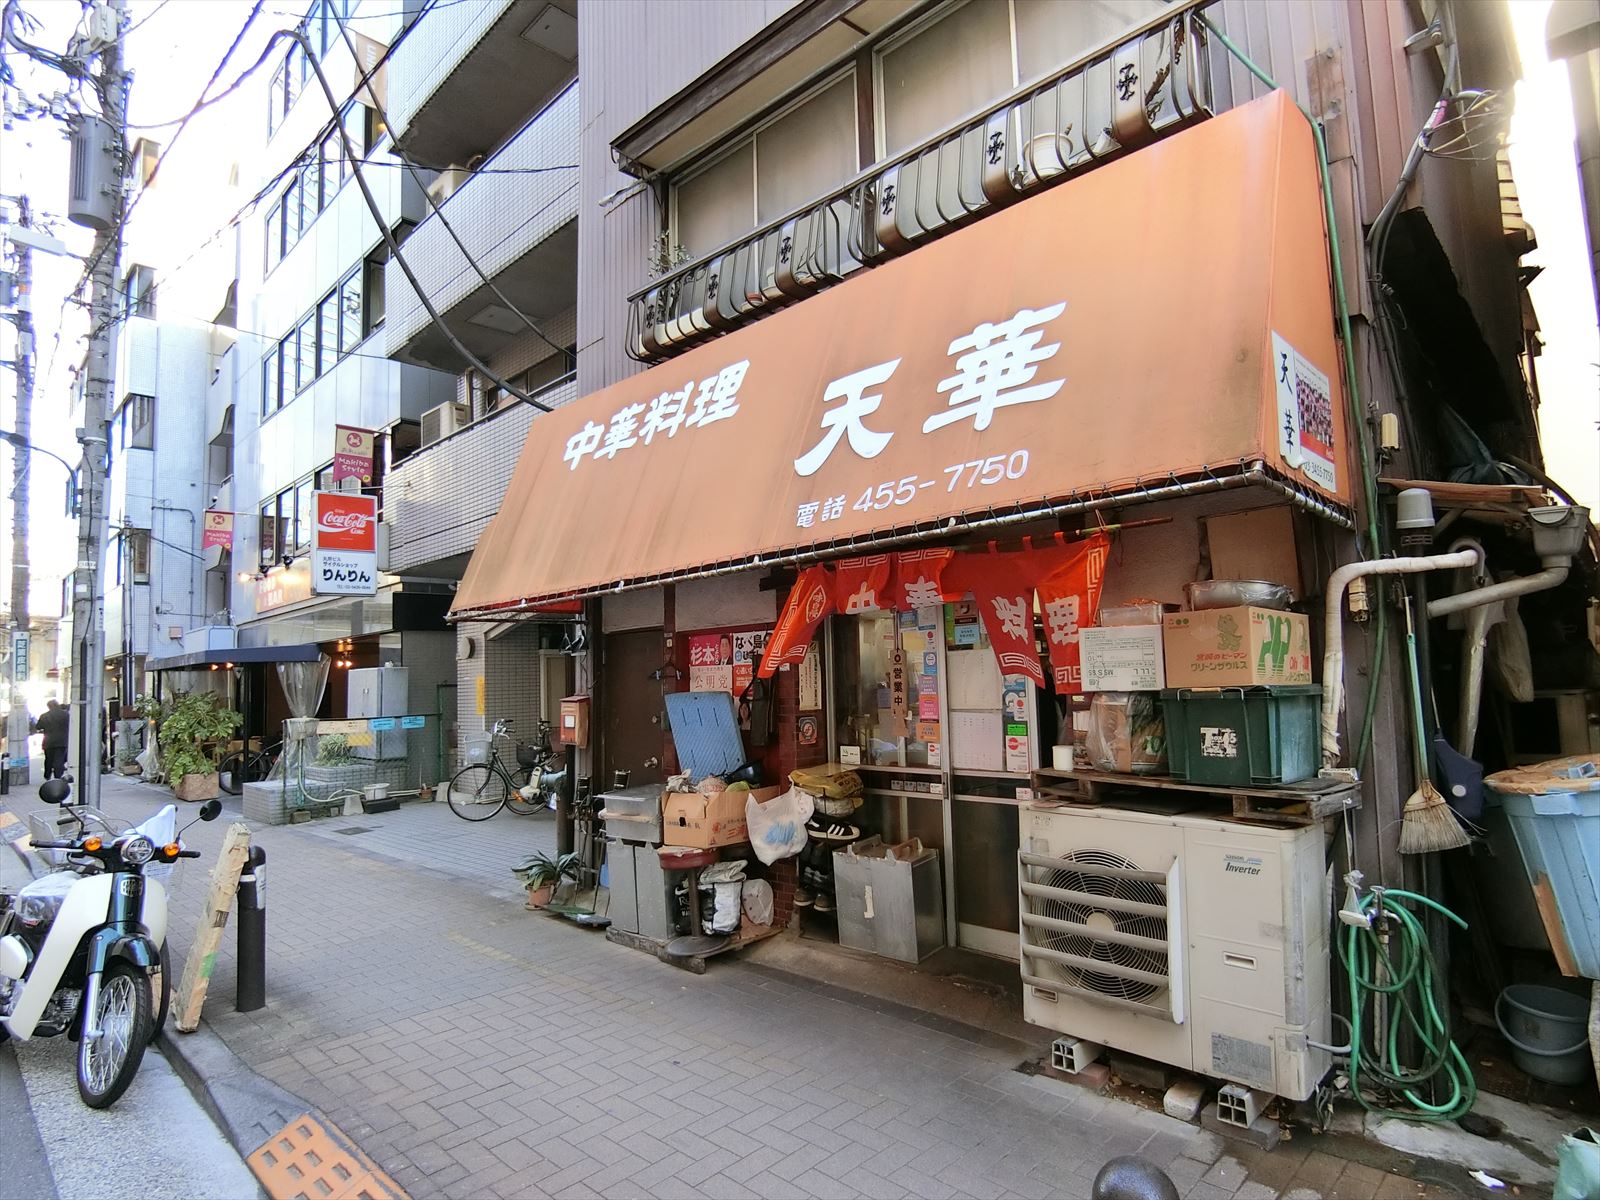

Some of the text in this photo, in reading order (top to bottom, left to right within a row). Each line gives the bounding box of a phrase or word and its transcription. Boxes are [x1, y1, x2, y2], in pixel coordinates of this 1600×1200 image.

[563, 359, 750, 470] 中華料理
[796, 495, 846, 528] 電話
[323, 568, 371, 583] りんりん
[690, 645, 715, 665] 杉本
[695, 674, 728, 689] 公明党
[1225, 861, 1261, 876] Inverter
